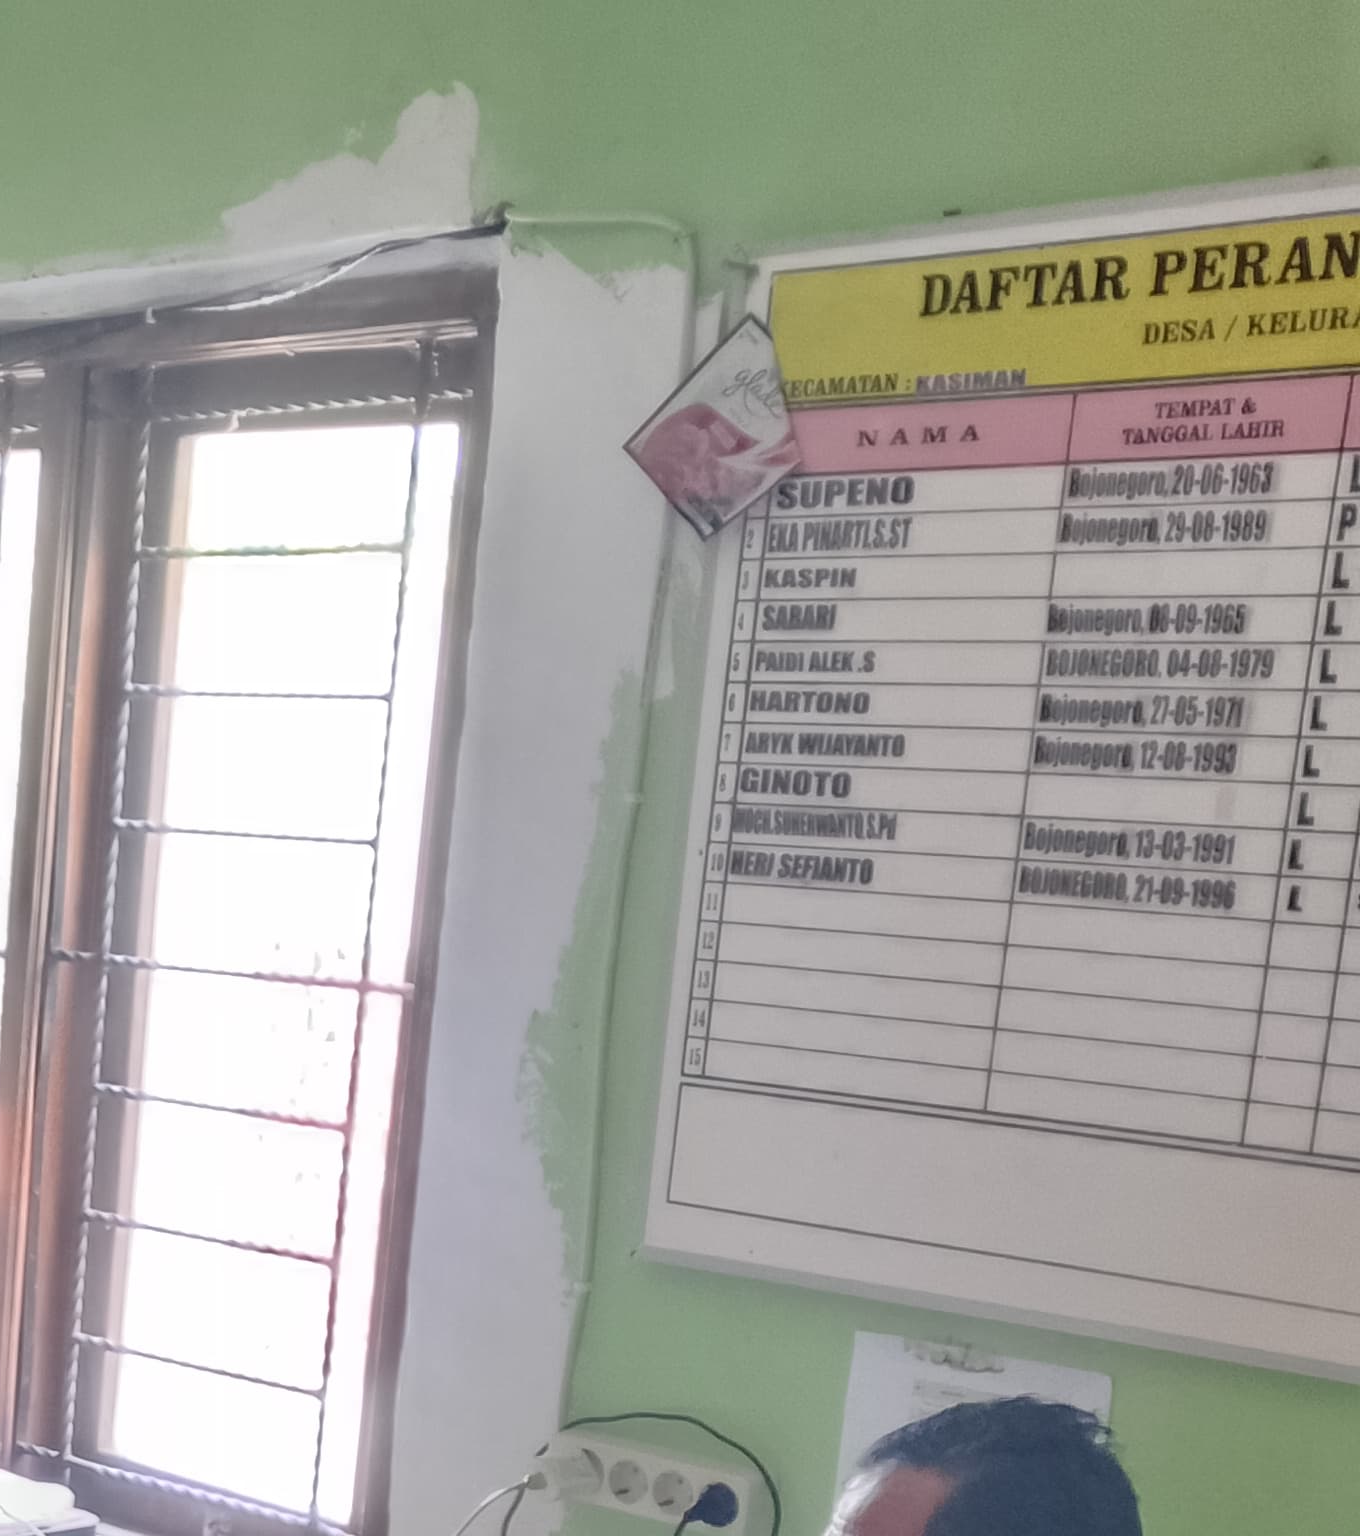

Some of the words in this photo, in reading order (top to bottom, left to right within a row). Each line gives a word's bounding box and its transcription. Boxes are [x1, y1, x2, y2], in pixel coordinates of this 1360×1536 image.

[919, 255, 1130, 318] DAFTAR
[1149, 230, 1360, 297] PERAN
[1142, 317, 1218, 346] DESA
[1223, 315, 1240, 342] /
[916, 368, 1027, 394] KASIMAN
[1154, 399, 1237, 419] TEMPAT
[1241, 398, 1257, 414] &
[1122, 425, 1214, 445] TANGGAL
[1221, 420, 1285, 440] LAHIR
[776, 476, 915, 509] SUPENO
[1164, 509, 1267, 543] 29-08-1989
[1336, 503, 1357, 541] P
[764, 568, 857, 589] KASPIN
[1332, 551, 1349, 589] L
[1324, 600, 1342, 636] L
[732, 652, 740, 672] 5
[808, 651, 854, 673] ALEK
[1320, 649, 1337, 683] L
[750, 690, 871, 714] HARTONO
[1310, 695, 1328, 731] L
[797, 733, 906, 757] WIJAYANTO
[1302, 744, 1320, 778] L
[740, 768, 851, 798] GINOTO
[1297, 792, 1314, 826] L
[711, 853, 724, 872] 10
[777, 853, 874, 885] SEFIANTO
[1287, 839, 1304, 870] L
[706, 893, 718, 911] 11
[1286, 885, 1303, 912] L
[702, 931, 715, 950] 12
[689, 1048, 701, 1066] 15
